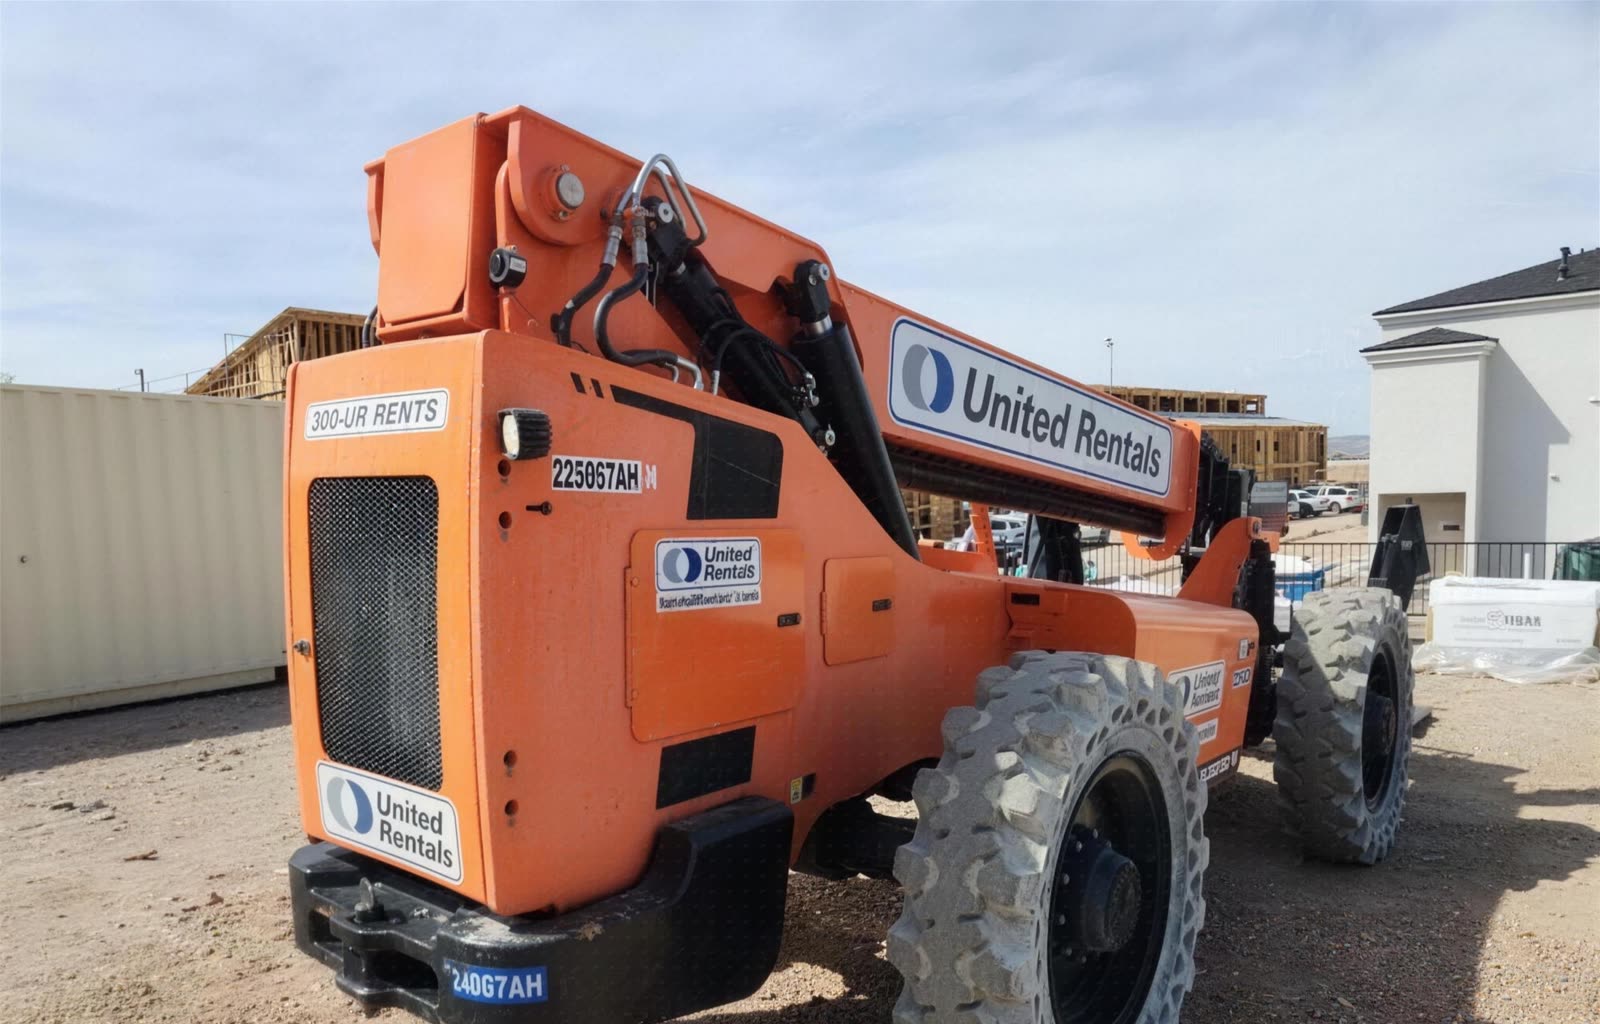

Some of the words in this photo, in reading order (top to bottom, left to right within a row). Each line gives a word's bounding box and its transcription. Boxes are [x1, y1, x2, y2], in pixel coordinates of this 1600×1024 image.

[311, 406, 367, 433] 300-UR
[375, 398, 438, 425] RENTS
[963, 367, 1071, 449] United
[1074, 409, 1162, 478] Rentals
[552, 458, 639, 491] 225067AH
[704, 545, 752, 563] United
[703, 563, 755, 582] Rentals
[377, 791, 443, 836] United
[379, 819, 453, 868] Rentals
